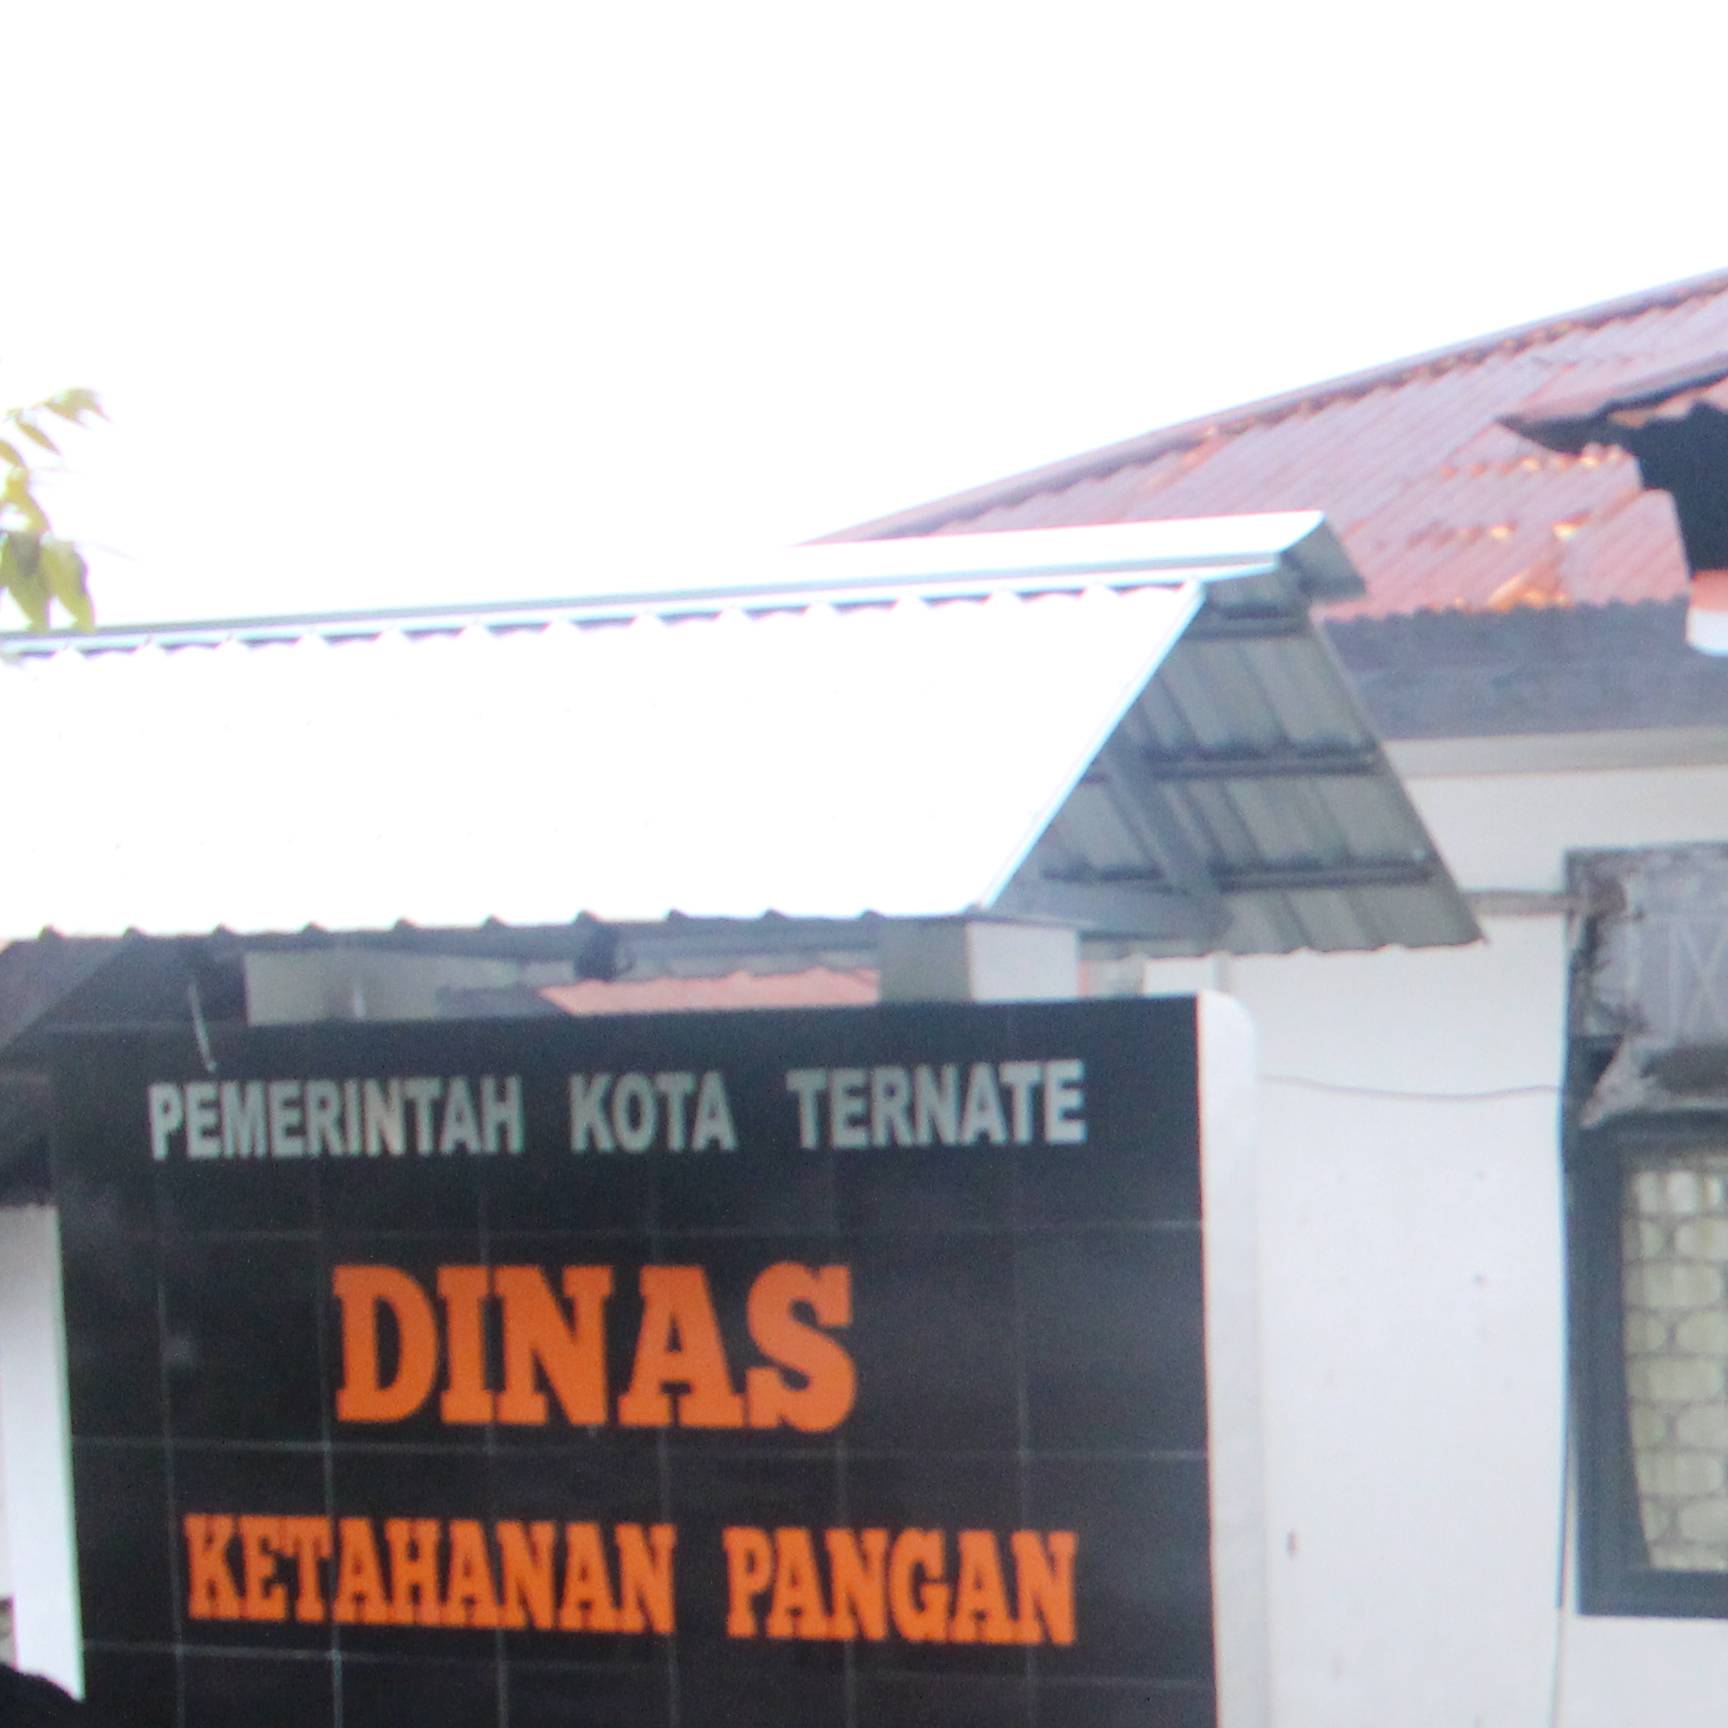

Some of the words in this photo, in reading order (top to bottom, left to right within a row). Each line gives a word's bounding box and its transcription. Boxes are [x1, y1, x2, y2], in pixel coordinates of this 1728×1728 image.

[149, 1075, 522, 1160] PEMERINTAH
[572, 1073, 734, 1150] KOTA
[788, 1058, 1088, 1148] TERNATE
[333, 1262, 856, 1432] DINAS
[184, 1515, 676, 1634] KETAHANAN
[723, 1526, 1078, 1645] PANGAN
